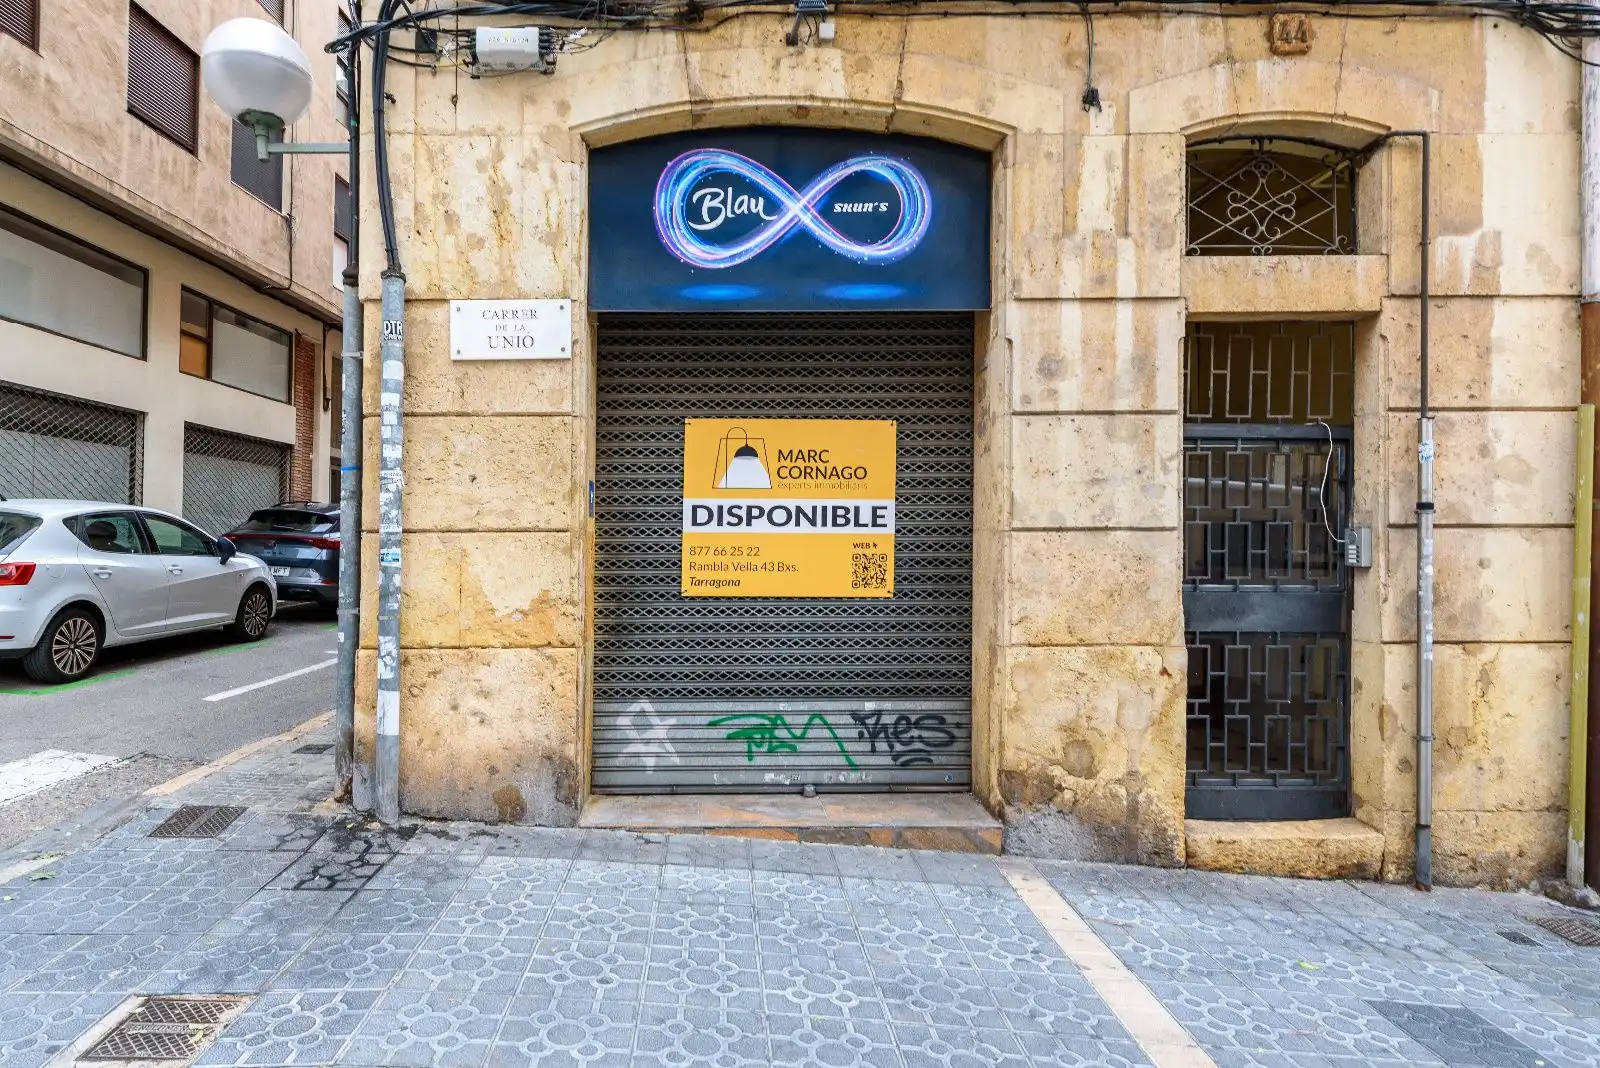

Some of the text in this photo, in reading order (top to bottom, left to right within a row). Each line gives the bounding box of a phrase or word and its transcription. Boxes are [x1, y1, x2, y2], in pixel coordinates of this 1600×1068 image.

[1277, 19, 1308, 44] 44
[687, 186, 778, 231] Blau
[481, 309, 539, 320] CARRER
[495, 324, 526, 332] DE LA
[488, 331, 535, 349] UNIÓ
[777, 449, 830, 463] MARC
[776, 465, 868, 480] CORNAGO
[691, 504, 888, 528] DISPONIBLE
[689, 546, 760, 556] 877 66 25 22
[689, 561, 799, 572] Rambla Vella 43 Bxs.
[690, 577, 741, 588] Tarragona
